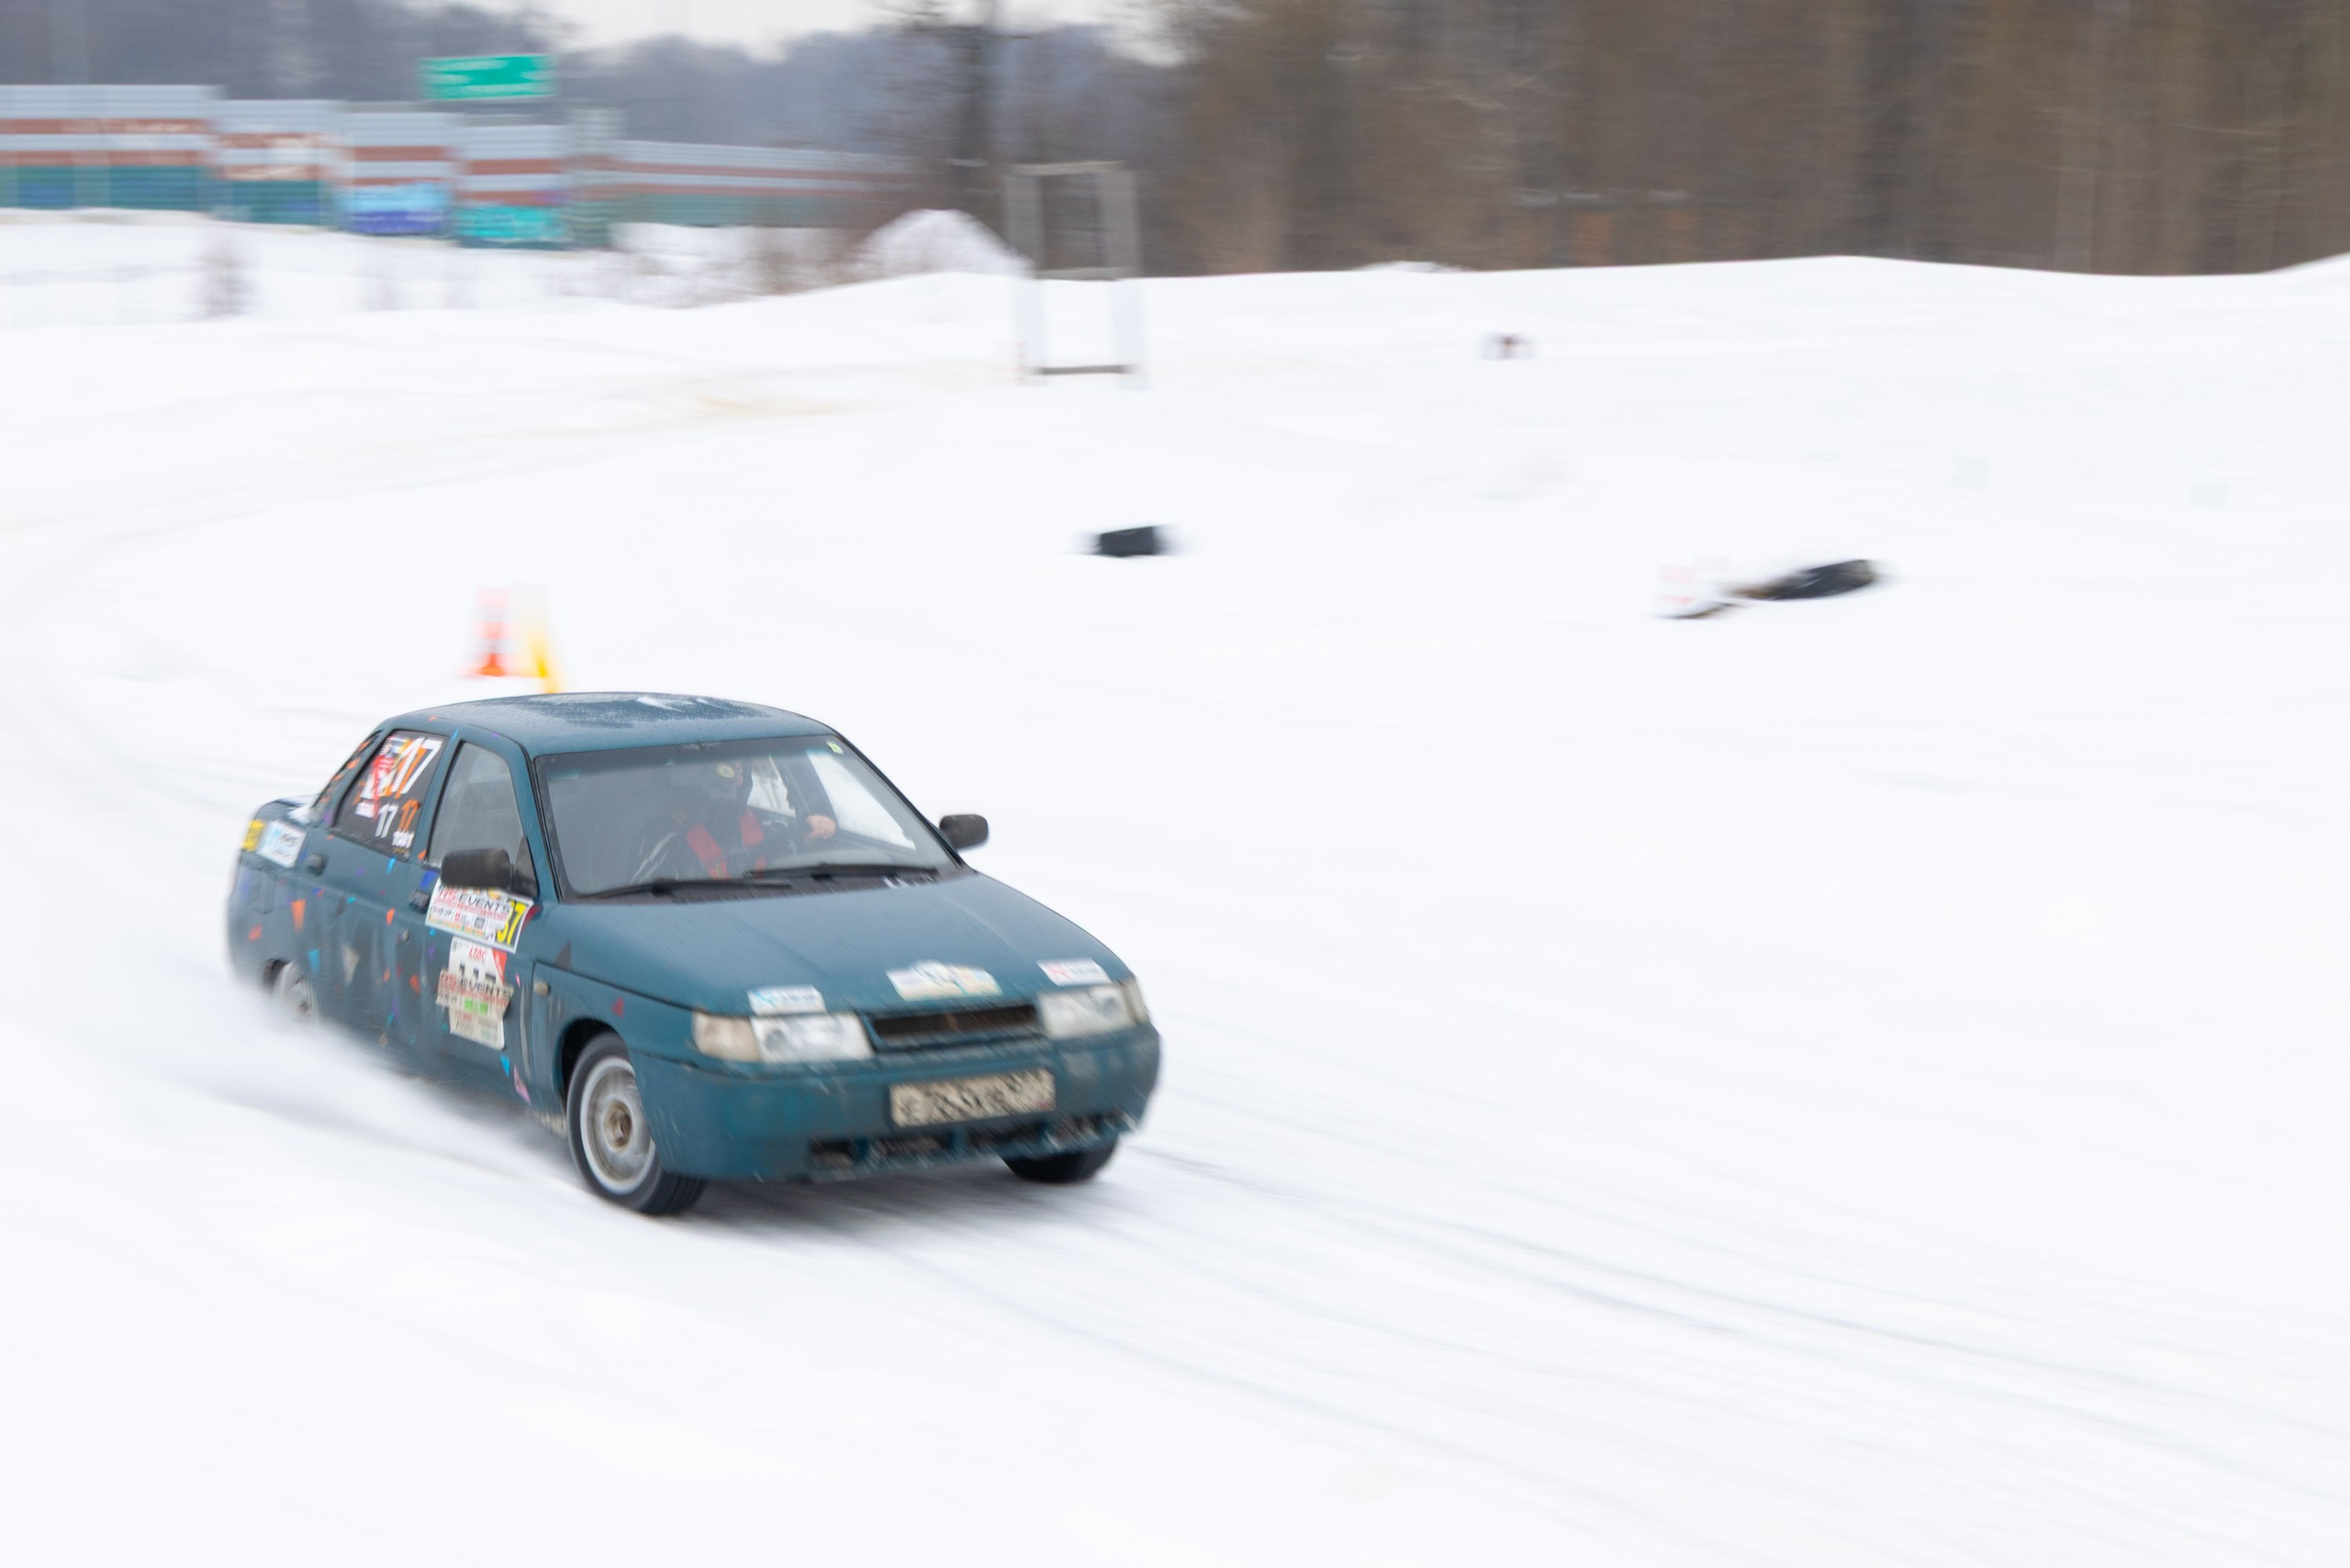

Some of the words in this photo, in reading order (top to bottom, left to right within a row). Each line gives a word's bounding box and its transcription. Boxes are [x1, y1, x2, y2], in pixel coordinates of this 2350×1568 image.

[389, 736, 443, 795] 17
[375, 802, 399, 838] 17
[398, 799, 420, 832] 17
[458, 893, 510, 913] EVENTS
[459, 978, 510, 999] EVENTS
